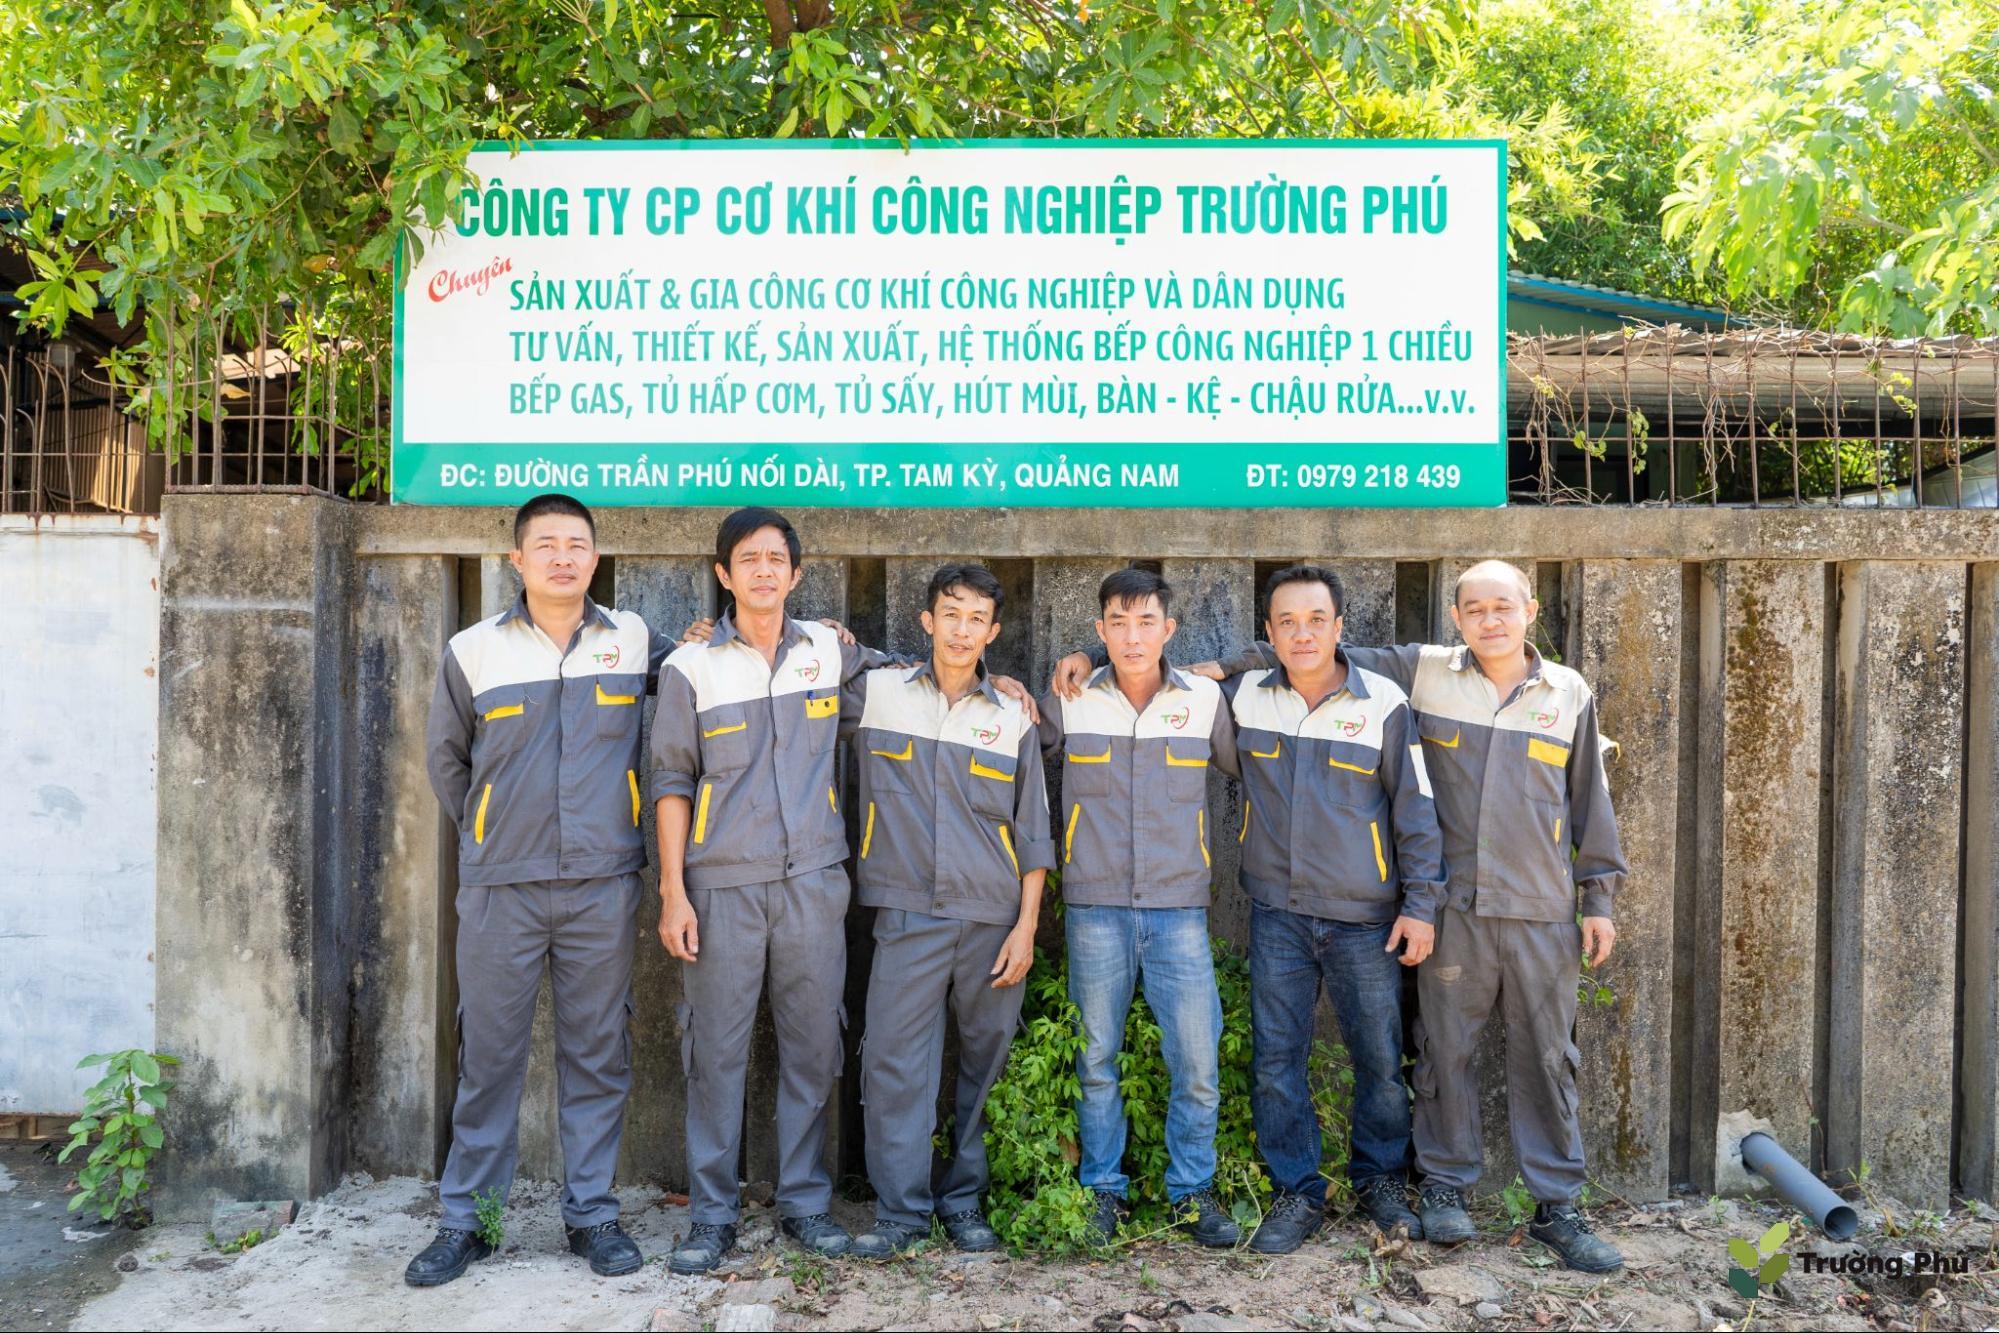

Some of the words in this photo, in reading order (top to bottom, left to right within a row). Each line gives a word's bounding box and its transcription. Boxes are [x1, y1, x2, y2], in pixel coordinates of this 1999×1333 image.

[455, 178, 569, 237] CÔNG
[583, 187, 630, 236] TY
[646, 187, 700, 235] CP
[716, 181, 773, 235] CƠ
[787, 176, 856, 235] KHÍ
[872, 176, 988, 235] CÔNG
[1004, 175, 1162, 246] NGHIỆP
[1176, 174, 1347, 235] TRƯỜNG
[1363, 175, 1447, 235] PHÚ
[428, 256, 512, 303] Chuyên
[510, 270, 565, 311] SẢN
[576, 269, 650, 311] XUẤT
[660, 279, 680, 310] &
[690, 279, 739, 310] GIA
[749, 273, 825, 309] CÔNG
[836, 278, 871, 309] CƠ
[881, 271, 930, 309] KHÍ
[940, 272, 1017, 309] CÔNG
[1028, 272, 1135, 315] NGHIỆP
[1144, 271, 1182, 309] VÀ
[1193, 272, 1252, 309] DÂN
[1264, 277, 1344, 316] DỤNG
[510, 330, 548, 362] TƯ
[556, 321, 622, 366] VẤN,
[633, 321, 714, 362] THIẾT
[725, 321, 766, 366] KẾ,
[777, 322, 832, 362] SẢN
[843, 321, 928, 366] XUẤT,
[939, 324, 974, 367] HỆ
[983, 320, 1083, 361] THỐNG
[1094, 320, 1147, 362] BẾP
[1156, 324, 1233, 362] CÔNG
[1244, 324, 1352, 367] NGHIỆP
[1362, 330, 1377, 361] 1
[1389, 320, 1472, 362] CHIỀU
[510, 373, 561, 414] BẾP
[571, 382, 632, 418] GAS,
[643, 374, 678, 414] TỦ
[690, 373, 746, 414] HẤP
[756, 382, 825, 418] CƠM,
[836, 374, 871, 414] TỦ
[882, 373, 944, 418] SẤY,
[954, 376, 1012, 414] HÚT
[1022, 375, 1086, 418] MÙI,
[1097, 376, 1156, 414] BÀN
[1187, 376, 1221, 420] KỆ
[1250, 376, 1326, 420] CHẬU
[440, 464, 485, 487] ĐC:
[495, 458, 588, 487] ĐƯỜNG
[598, 454, 668, 487] TRẦN
[678, 458, 731, 487] PHÚ
[742, 455, 784, 487] NỐI
[795, 458, 845, 490] DÀI,
[854, 464, 890, 487] TP.
[900, 464, 952, 487] TAM
[963, 458, 1006, 490] KỲ,
[1015, 455, 1111, 488] QUẢNG
[1122, 464, 1178, 487] NAM
[1247, 464, 1287, 487] ĐT:
[1298, 464, 1355, 488] 0979
[1366, 464, 1408, 488] 218
[1417, 464, 1460, 488] 439
